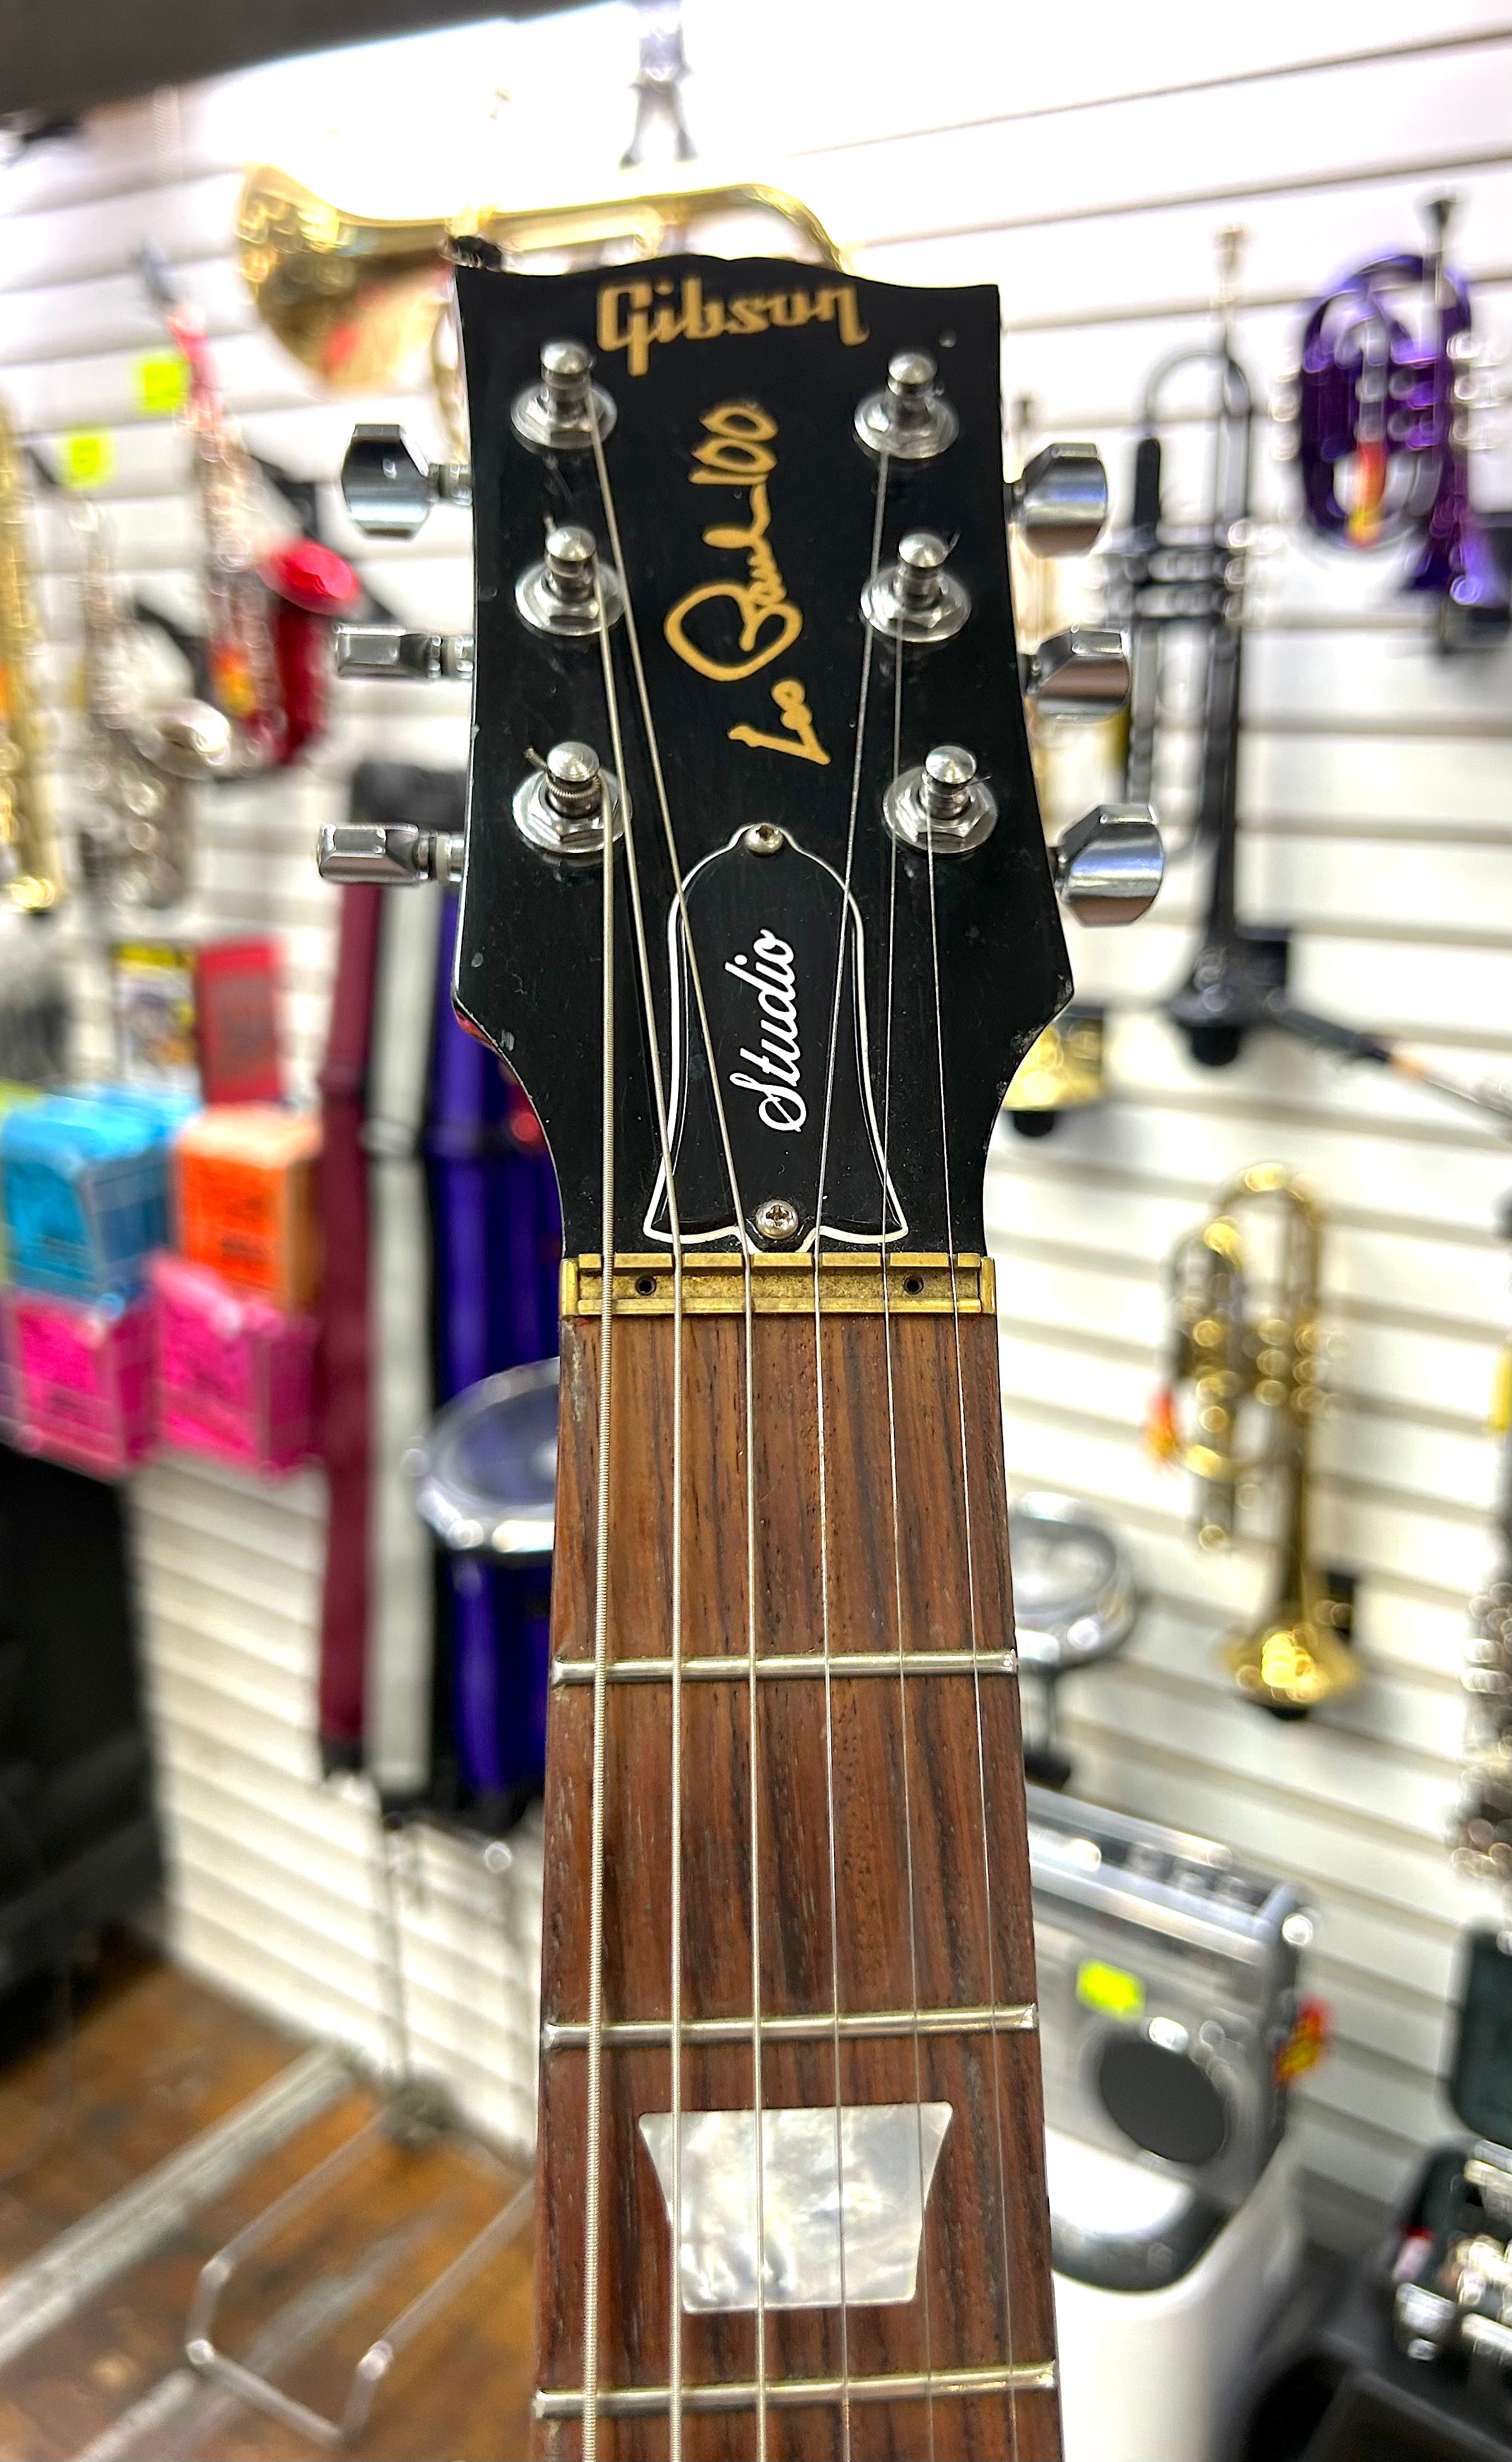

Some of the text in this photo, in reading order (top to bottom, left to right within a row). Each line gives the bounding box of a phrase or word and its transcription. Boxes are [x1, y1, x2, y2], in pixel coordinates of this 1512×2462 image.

[597, 274, 870, 377] Gibson
[664, 484, 803, 681] Paul
[728, 678, 831, 765] Les
[724, 927, 807, 1133] Studio
